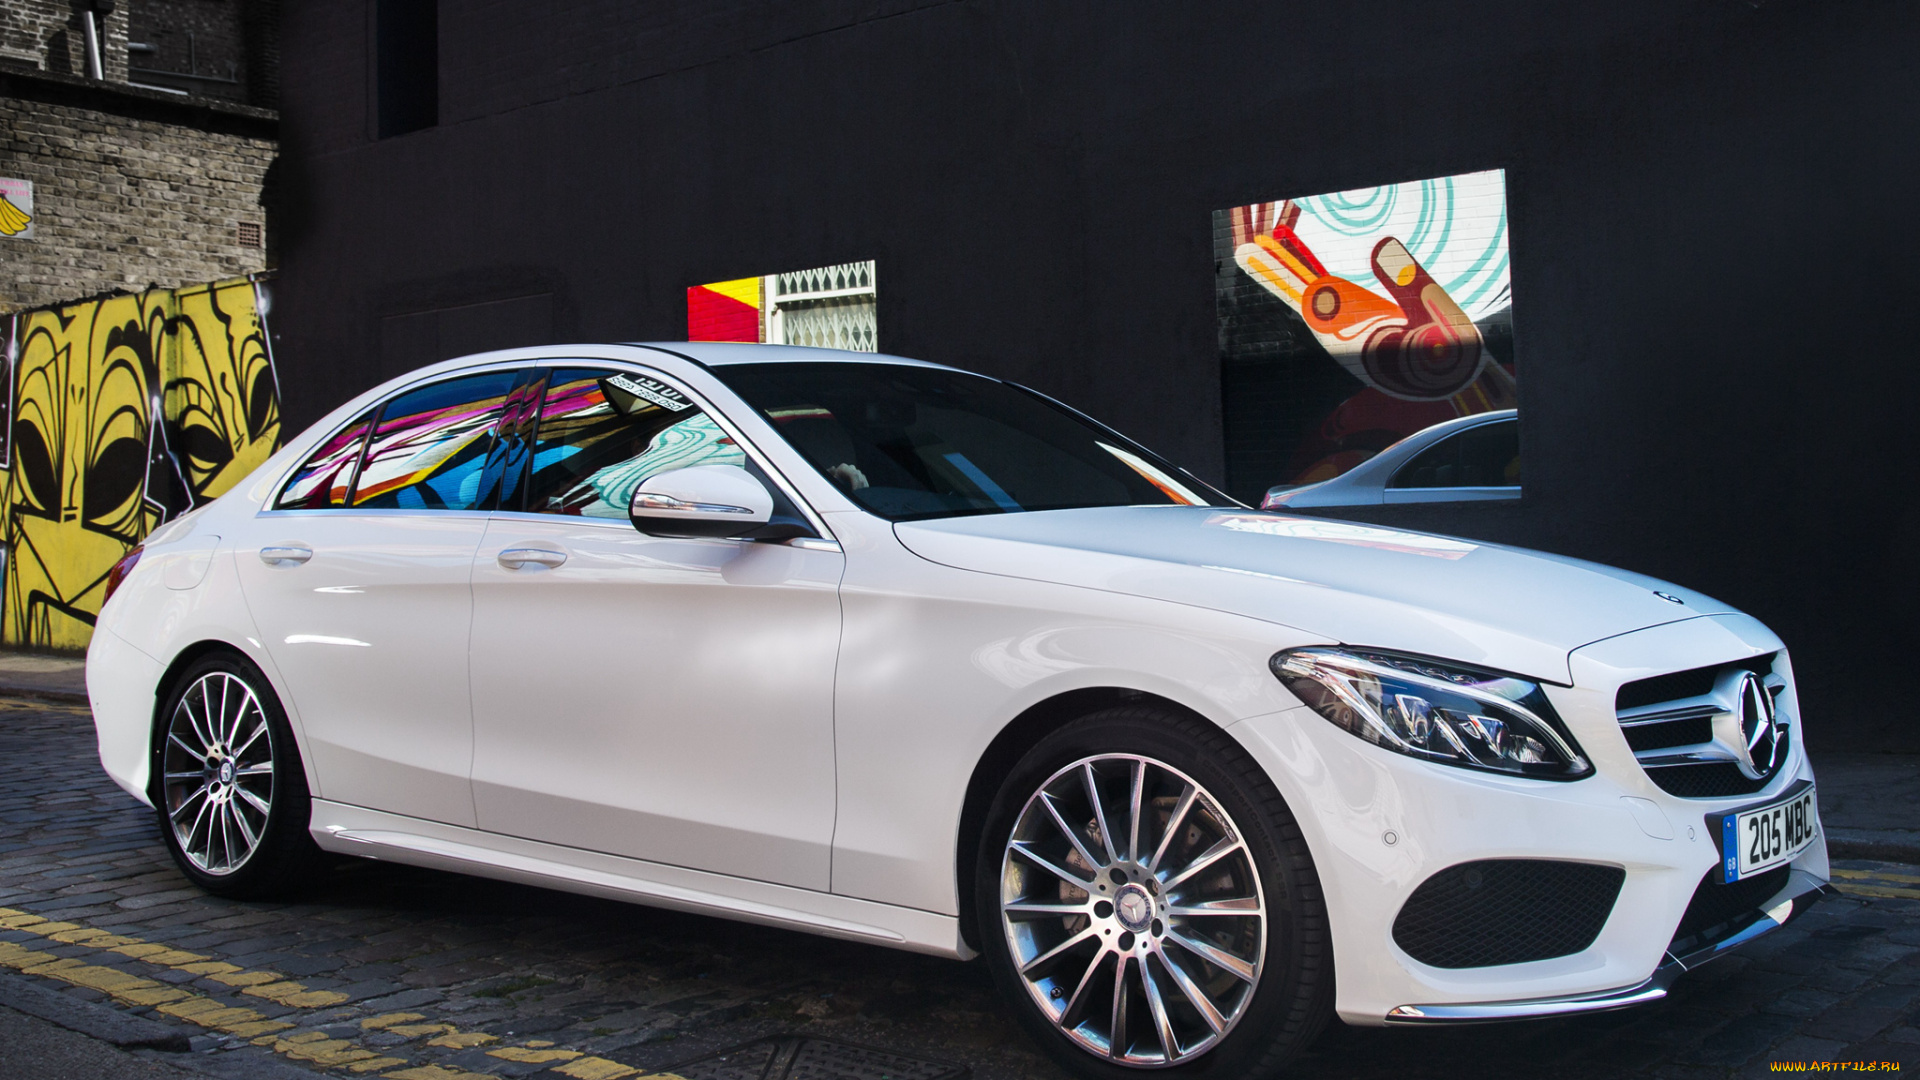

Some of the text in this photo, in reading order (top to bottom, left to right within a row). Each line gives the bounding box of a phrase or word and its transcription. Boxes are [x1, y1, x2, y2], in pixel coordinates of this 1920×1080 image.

[1749, 795, 1812, 864] 205 MBC
[1727, 857, 1736, 871] GB
